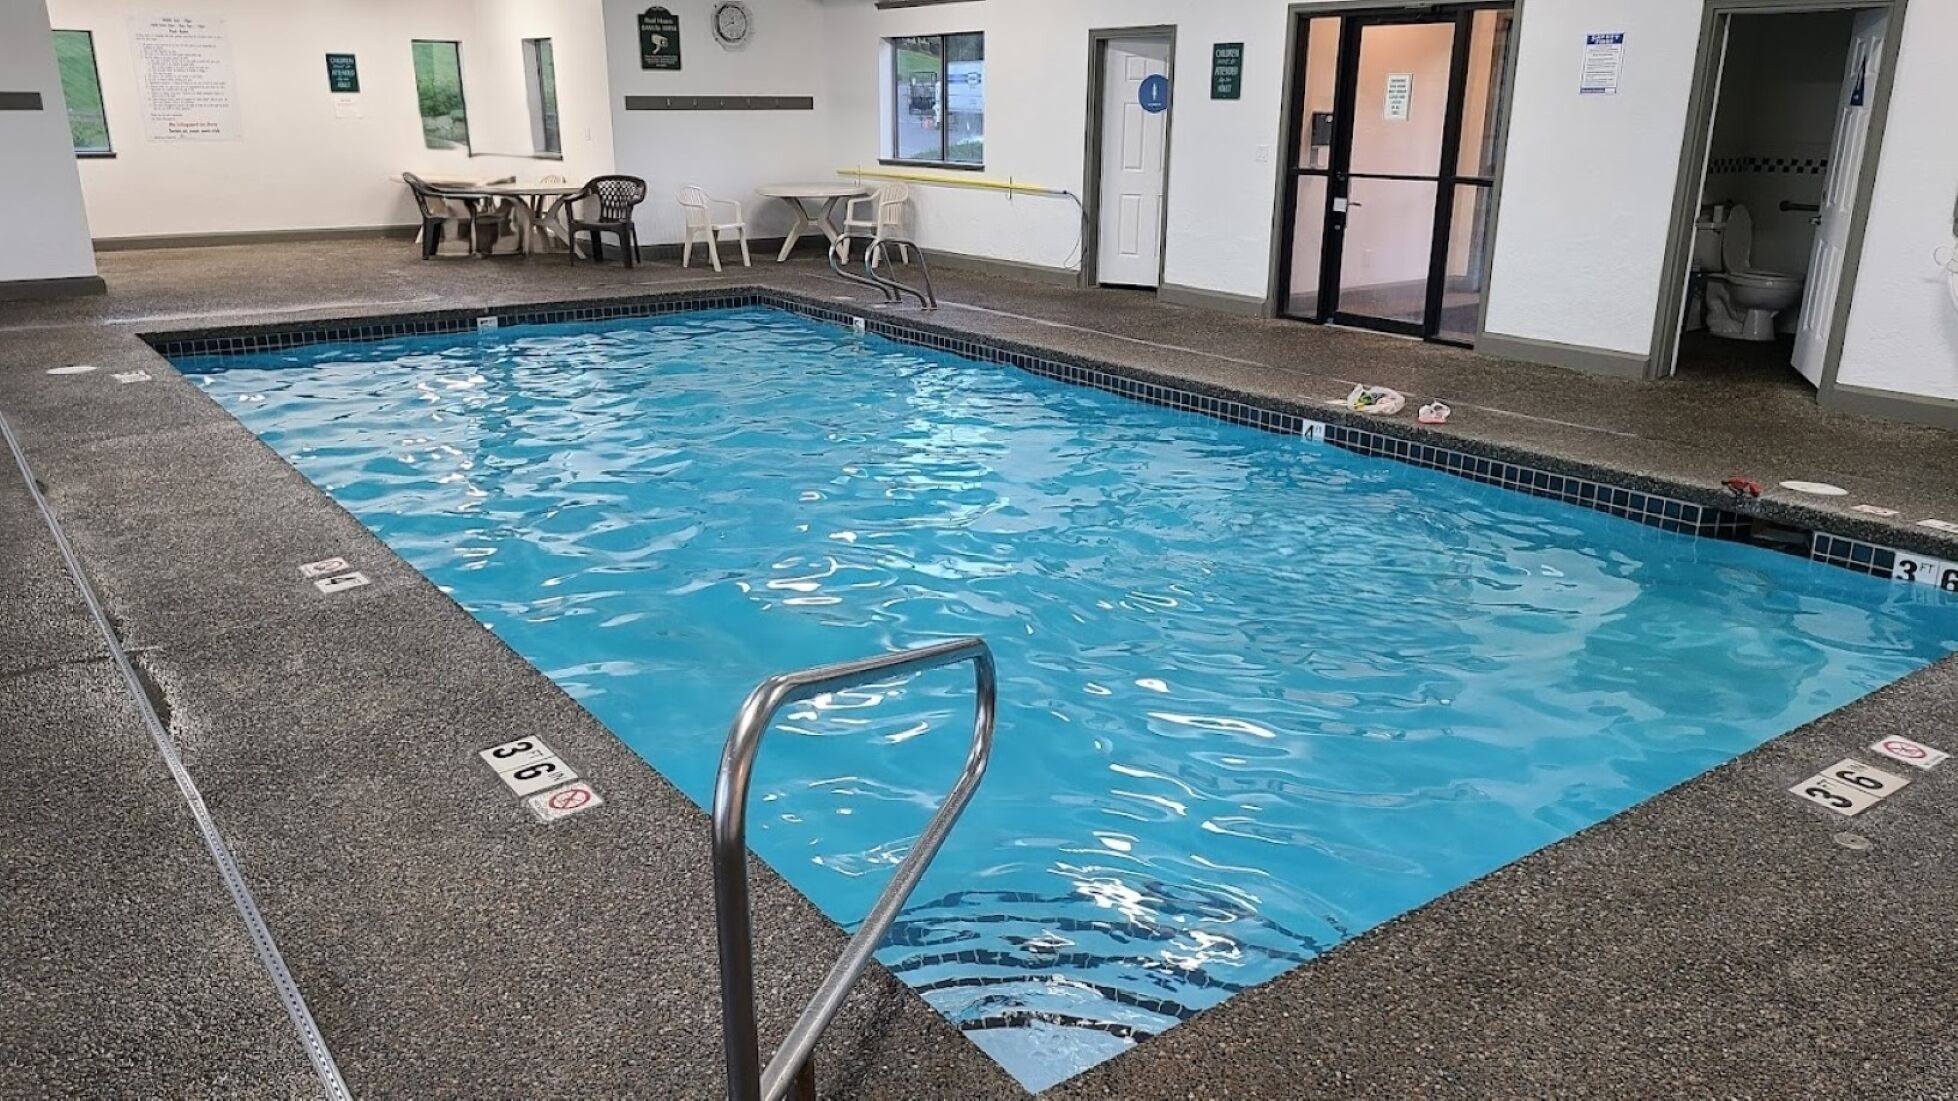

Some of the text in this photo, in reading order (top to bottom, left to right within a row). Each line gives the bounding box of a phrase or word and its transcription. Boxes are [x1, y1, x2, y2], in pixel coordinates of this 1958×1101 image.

[1215, 48, 1240, 58] CHILDREN
[1896, 559, 1958, 592] 3 FT 6
[492, 741, 534, 759] 3
[513, 763, 556, 780] 6
[1805, 787, 1853, 808] 3
[1835, 770, 1884, 790] 6
